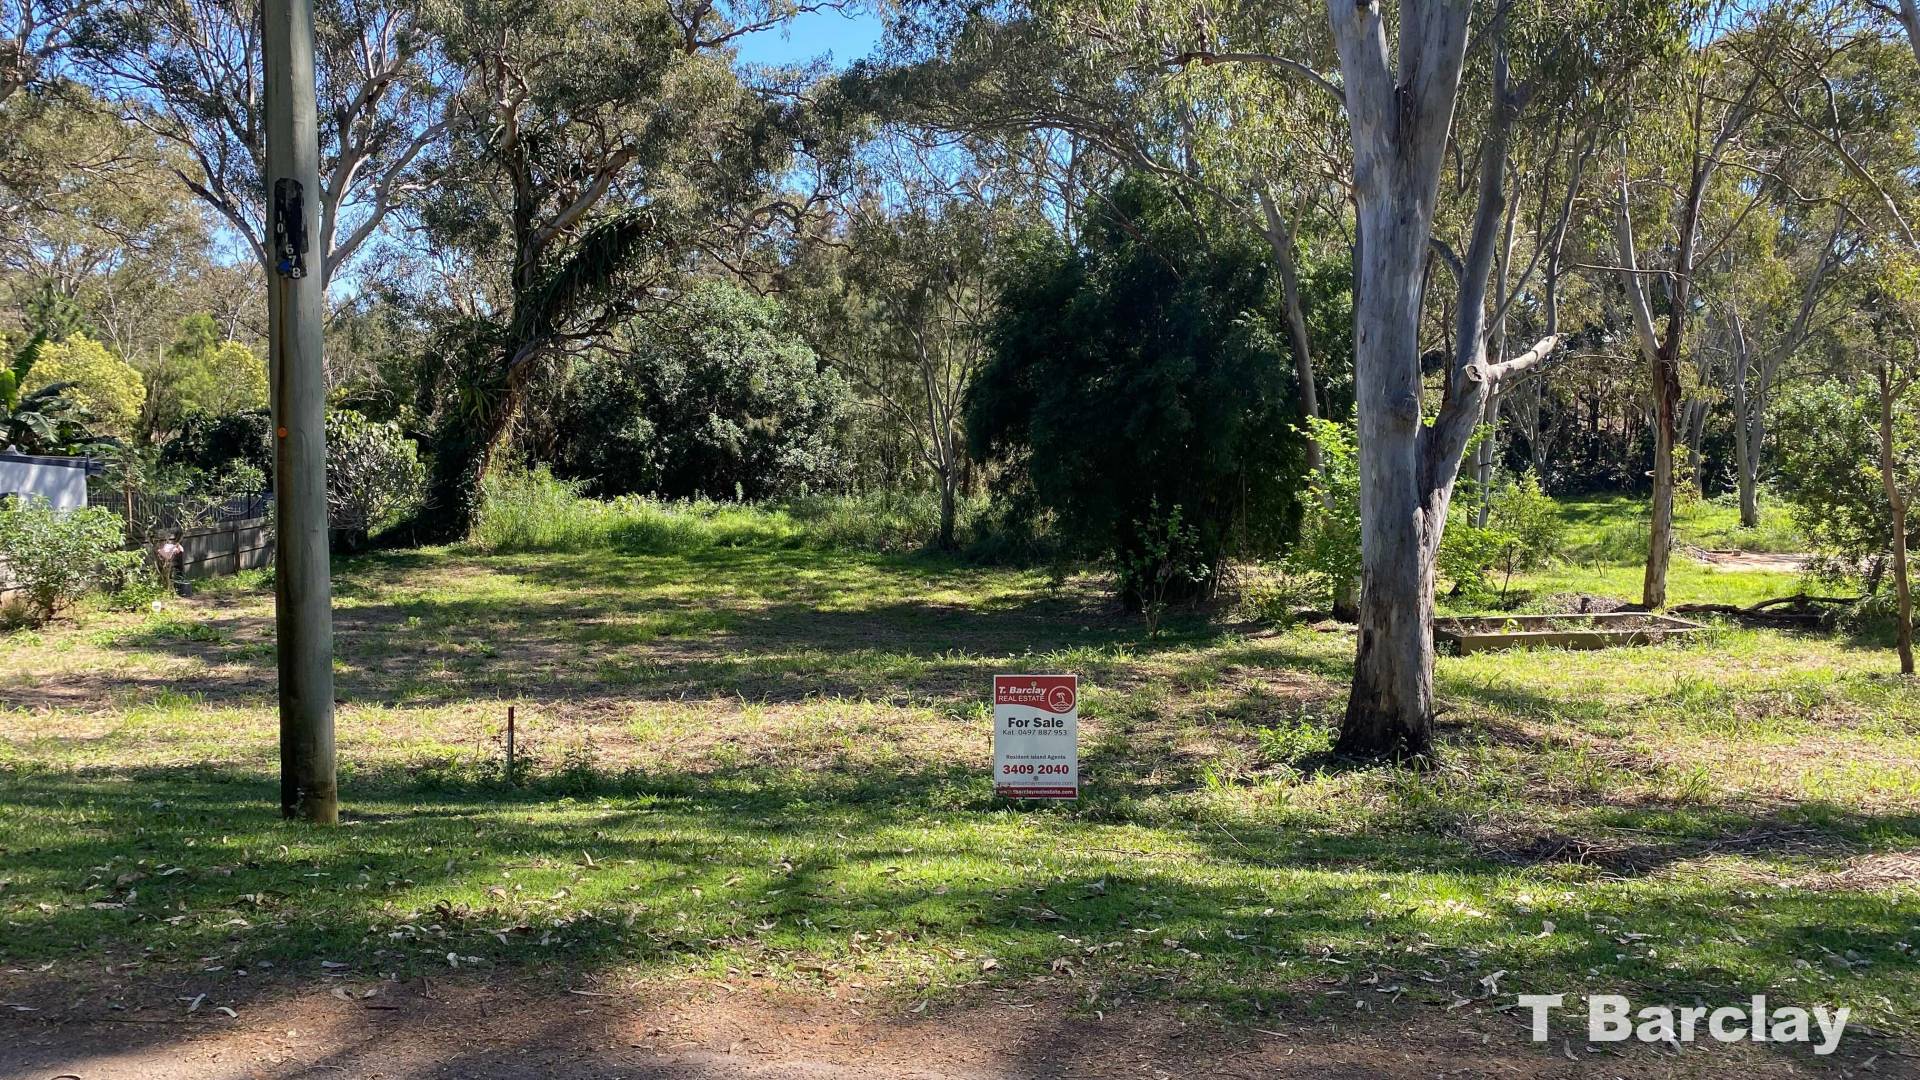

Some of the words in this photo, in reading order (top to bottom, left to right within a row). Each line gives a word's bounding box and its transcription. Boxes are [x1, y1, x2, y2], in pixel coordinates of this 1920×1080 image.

[998, 686, 1006, 694] T.
[1009, 686, 1047, 696] Barclay
[1008, 717, 1030, 728] For
[1033, 717, 1064, 728] Sale
[1002, 764, 1034, 775] 3409
[1037, 764, 1070, 775] 2040
